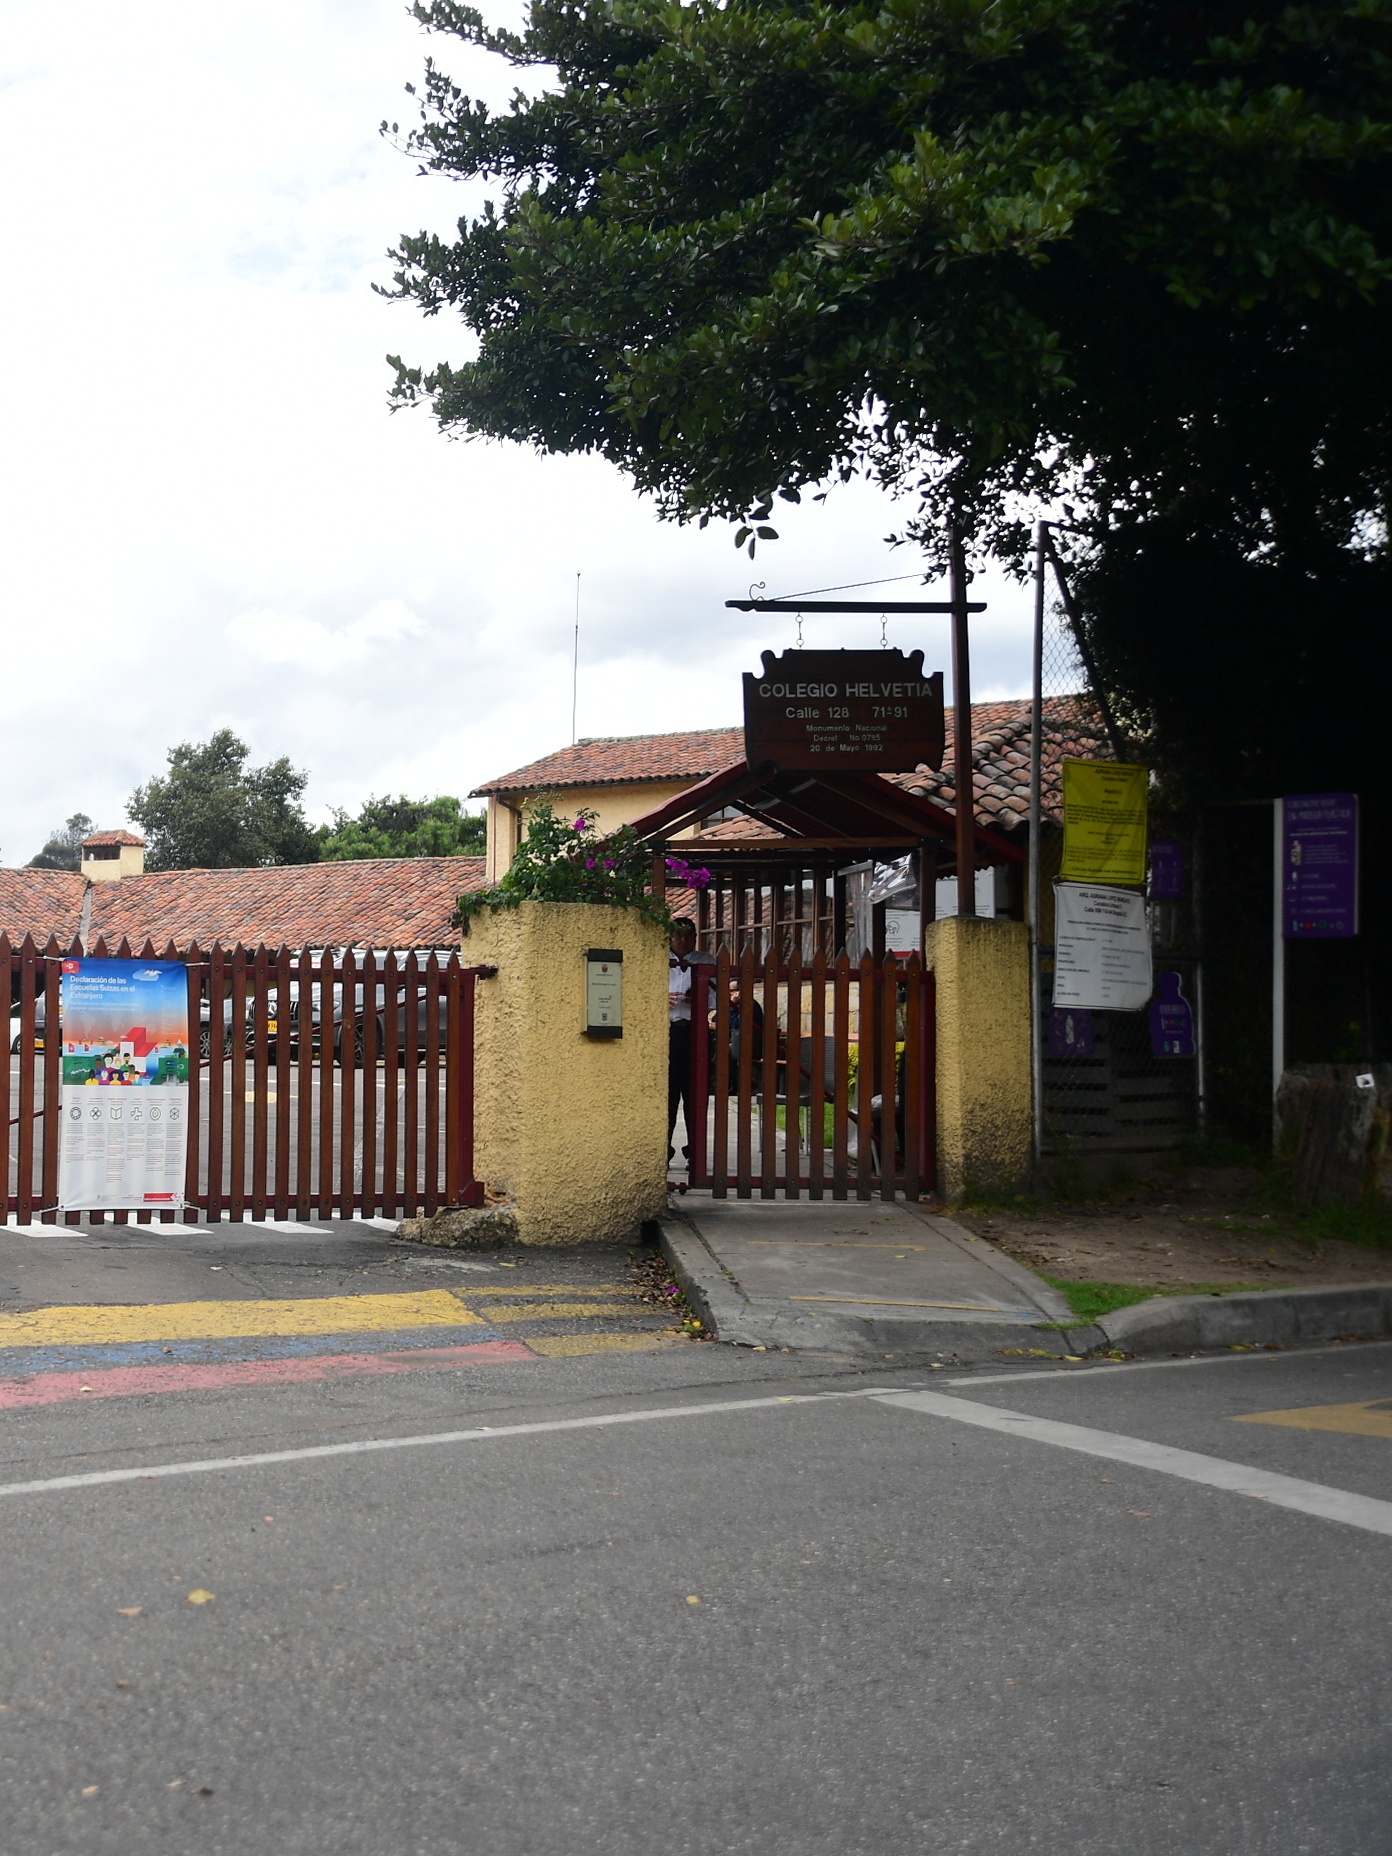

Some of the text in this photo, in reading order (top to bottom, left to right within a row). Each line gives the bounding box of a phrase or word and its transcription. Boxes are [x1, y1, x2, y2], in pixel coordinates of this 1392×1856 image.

[759, 682, 933, 697] COLEGIO HELVETIA
[785, 706, 820, 719] Calle
[828, 706, 849, 719] 128
[806, 724, 887, 732] Monumento Nacional
[810, 744, 820, 752] 20
[825, 744, 835, 752] de
[839, 744, 859, 752] Mayo
[70, 975, 107, 984] Declaración
[100, 984, 120, 992] Suizas
[70, 992, 103, 1000] Extranjero
